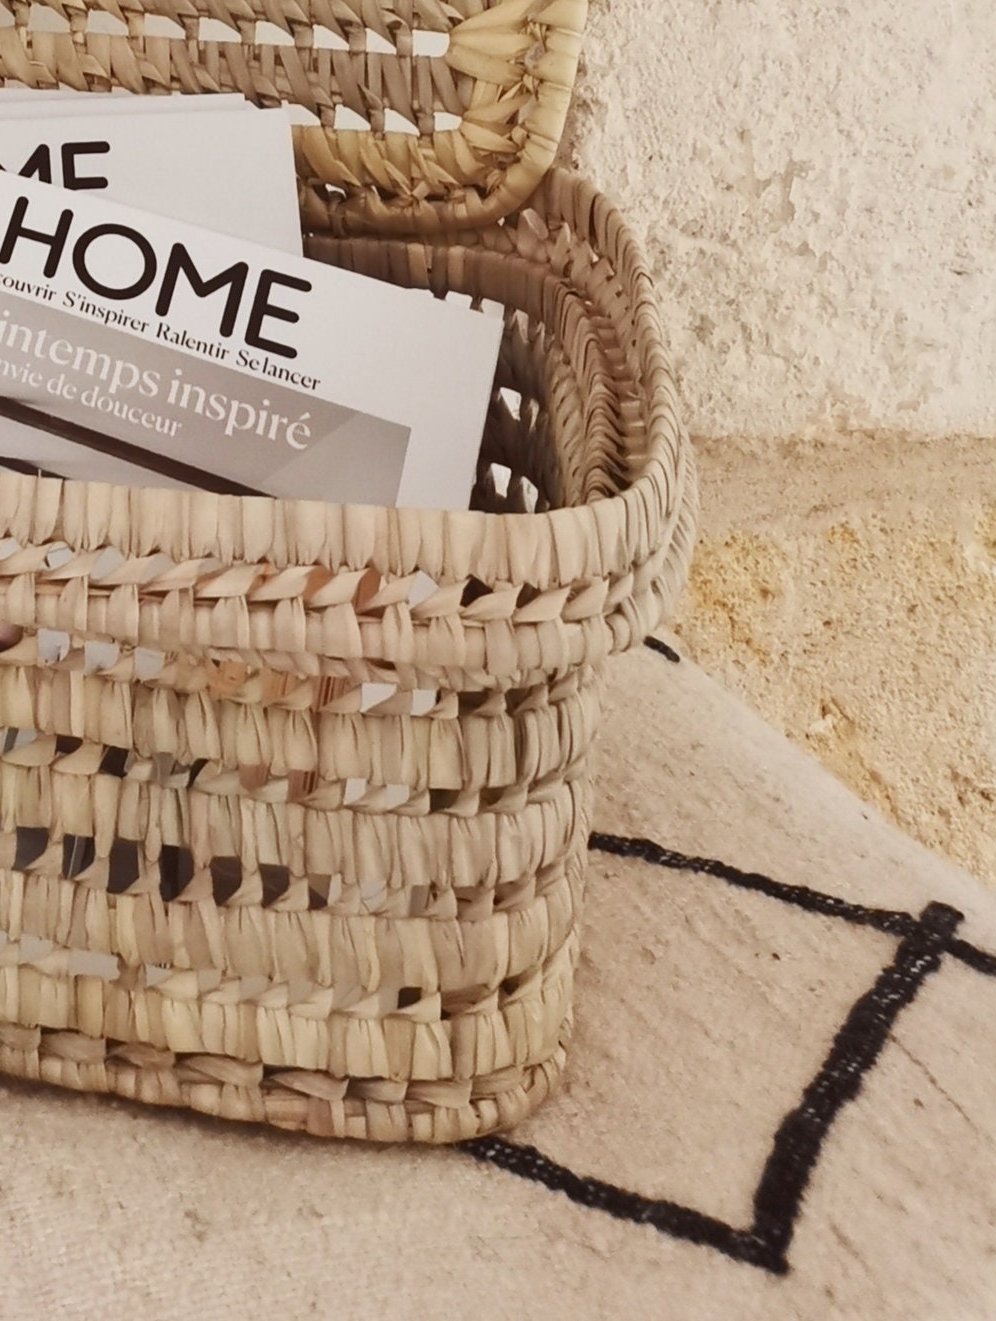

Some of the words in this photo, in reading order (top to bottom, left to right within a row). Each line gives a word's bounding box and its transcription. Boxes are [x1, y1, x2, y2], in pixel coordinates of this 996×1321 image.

[62, 291, 150, 333] S'inspirer
[156, 322, 230, 360] Ralentir
[46, 373, 77, 400] de
[81, 386, 183, 437] douceur
[167, 368, 311, 449] inspiré
